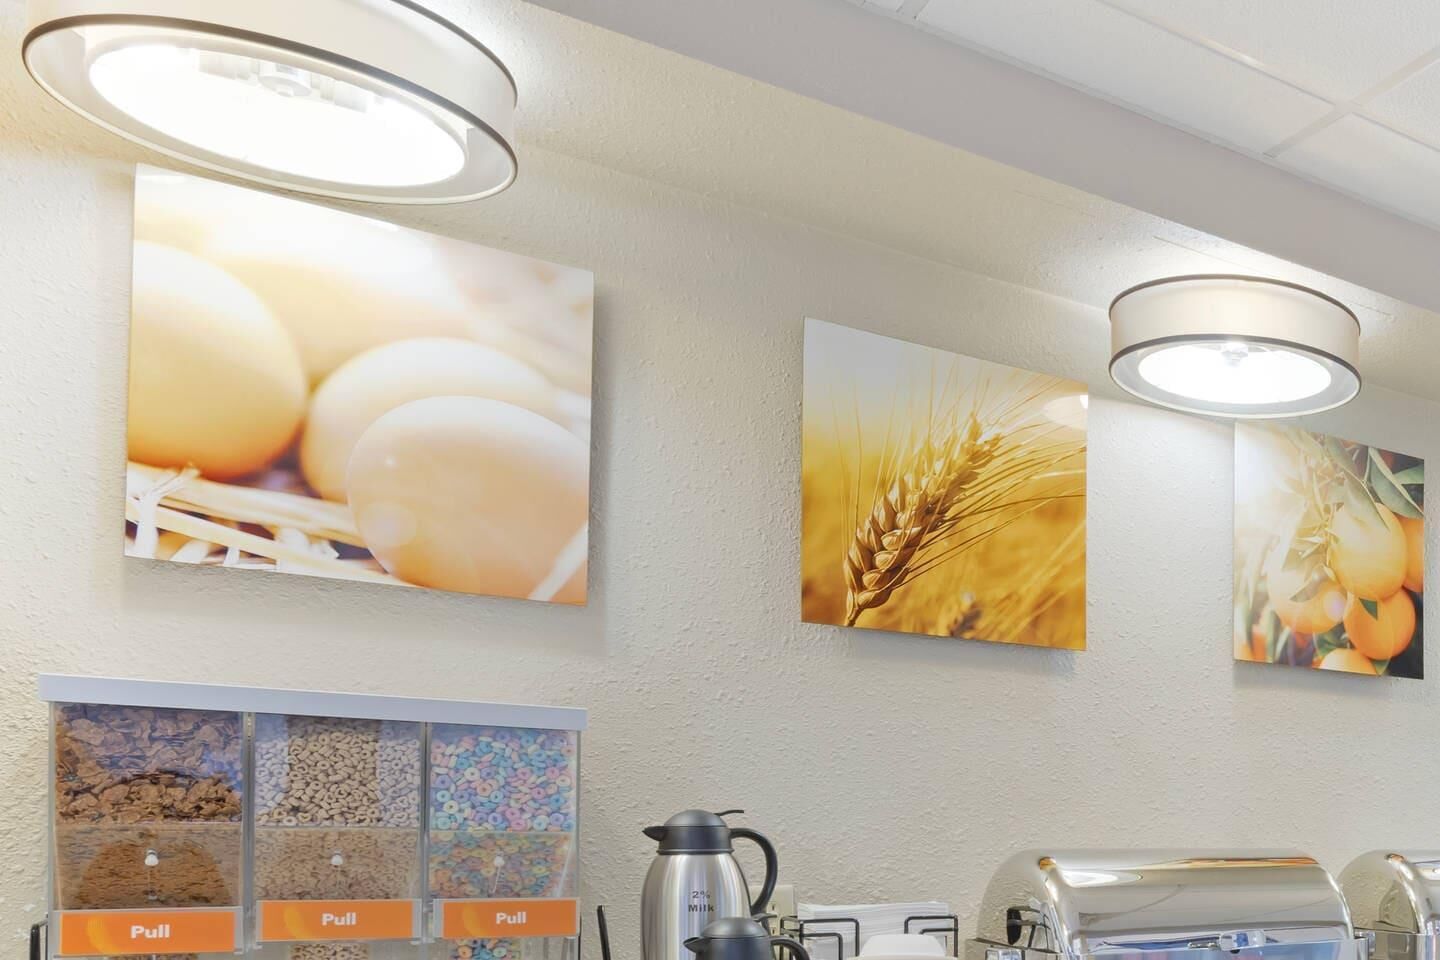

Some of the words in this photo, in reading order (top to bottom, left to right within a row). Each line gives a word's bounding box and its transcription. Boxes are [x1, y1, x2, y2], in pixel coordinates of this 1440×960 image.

[688, 903, 715, 912] Milk
[322, 912, 356, 925] Pull
[496, 912, 526, 924] Pull
[131, 924, 170, 938] Pull
